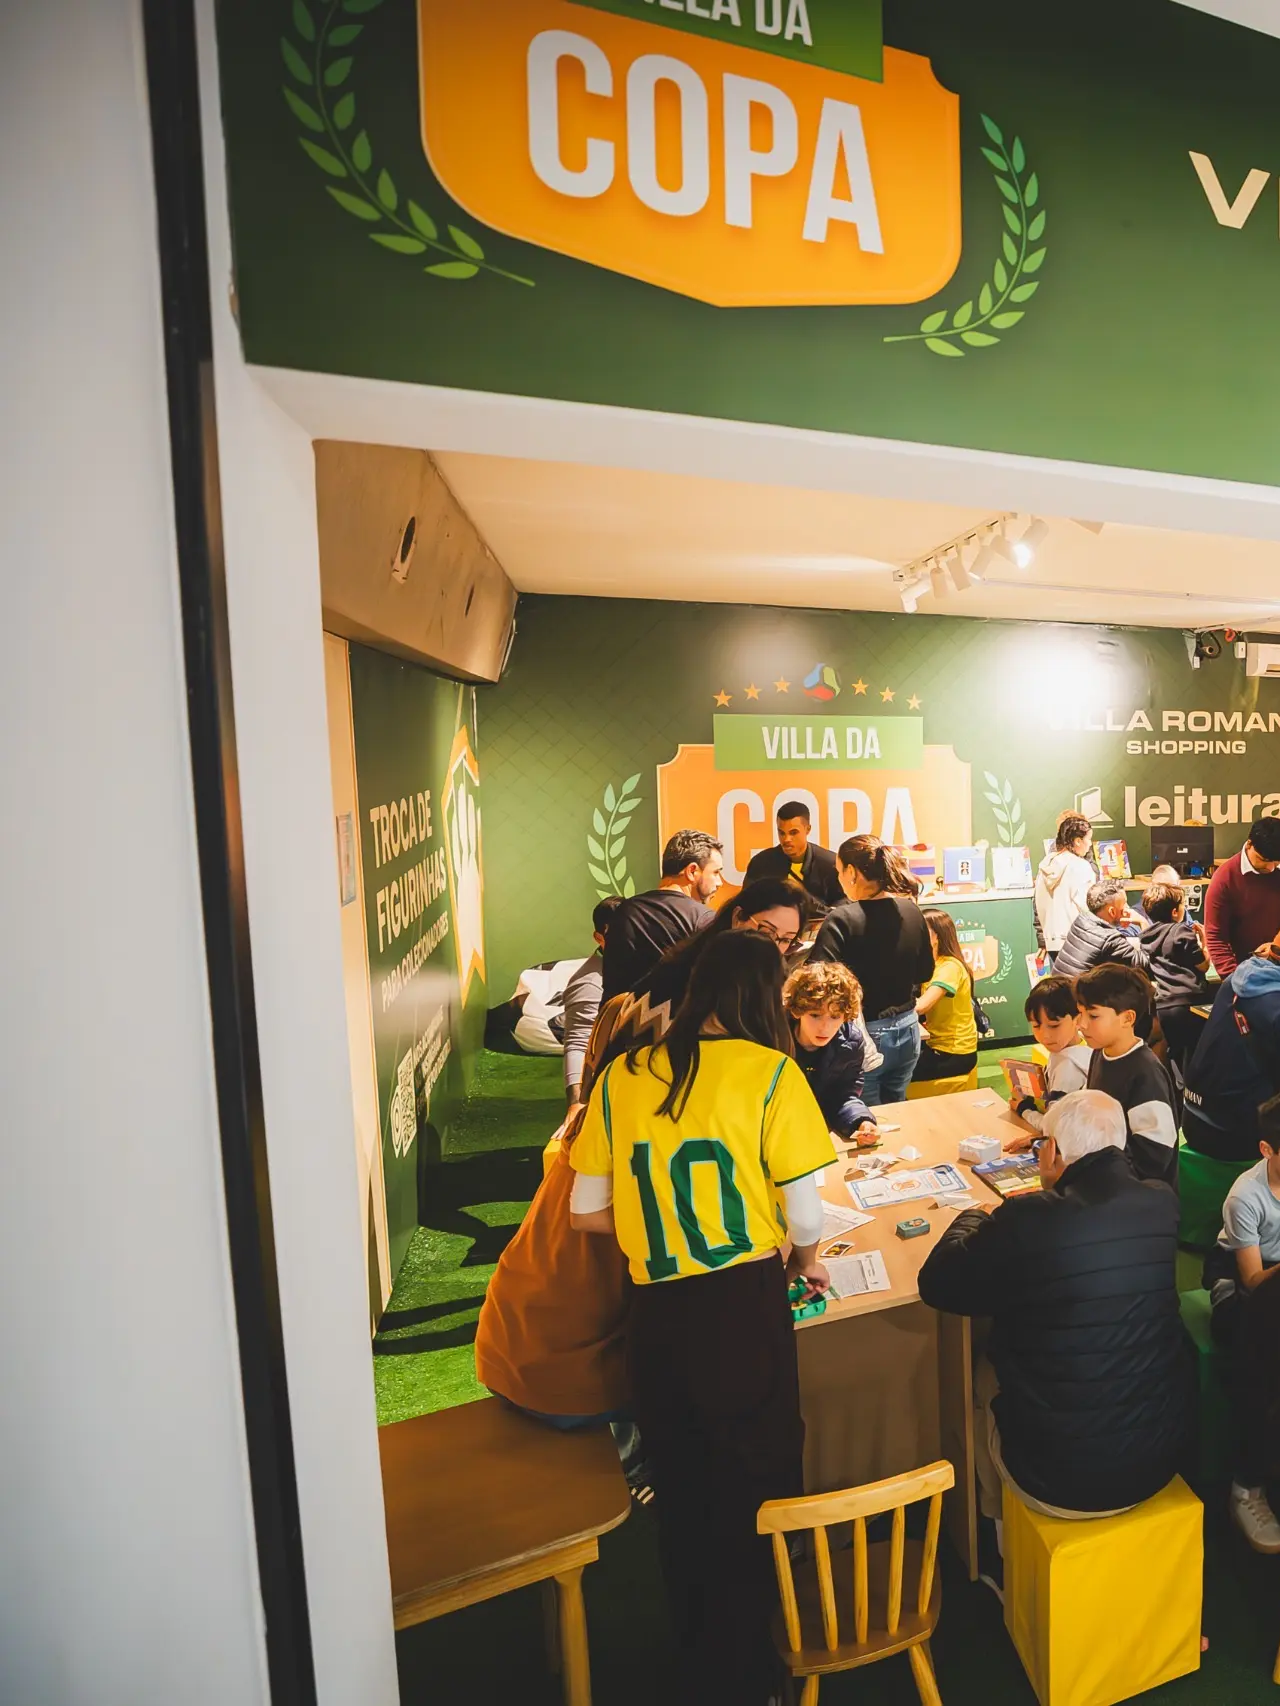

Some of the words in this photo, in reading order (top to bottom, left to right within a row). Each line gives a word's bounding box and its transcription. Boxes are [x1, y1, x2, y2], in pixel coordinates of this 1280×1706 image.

[755, 0, 813, 46] DA
[525, 29, 884, 255] COPA
[761, 726, 838, 759] VILLA
[846, 727, 881, 759] DA
[1126, 740, 1247, 755] SHOPPING
[369, 795, 418, 868] TROCA
[417, 790, 433, 842] DE
[376, 846, 447, 953] FIGURINHAS
[961, 947, 986, 972] PA
[381, 964, 403, 1013] PARA
[630, 1138, 753, 1282] 10
